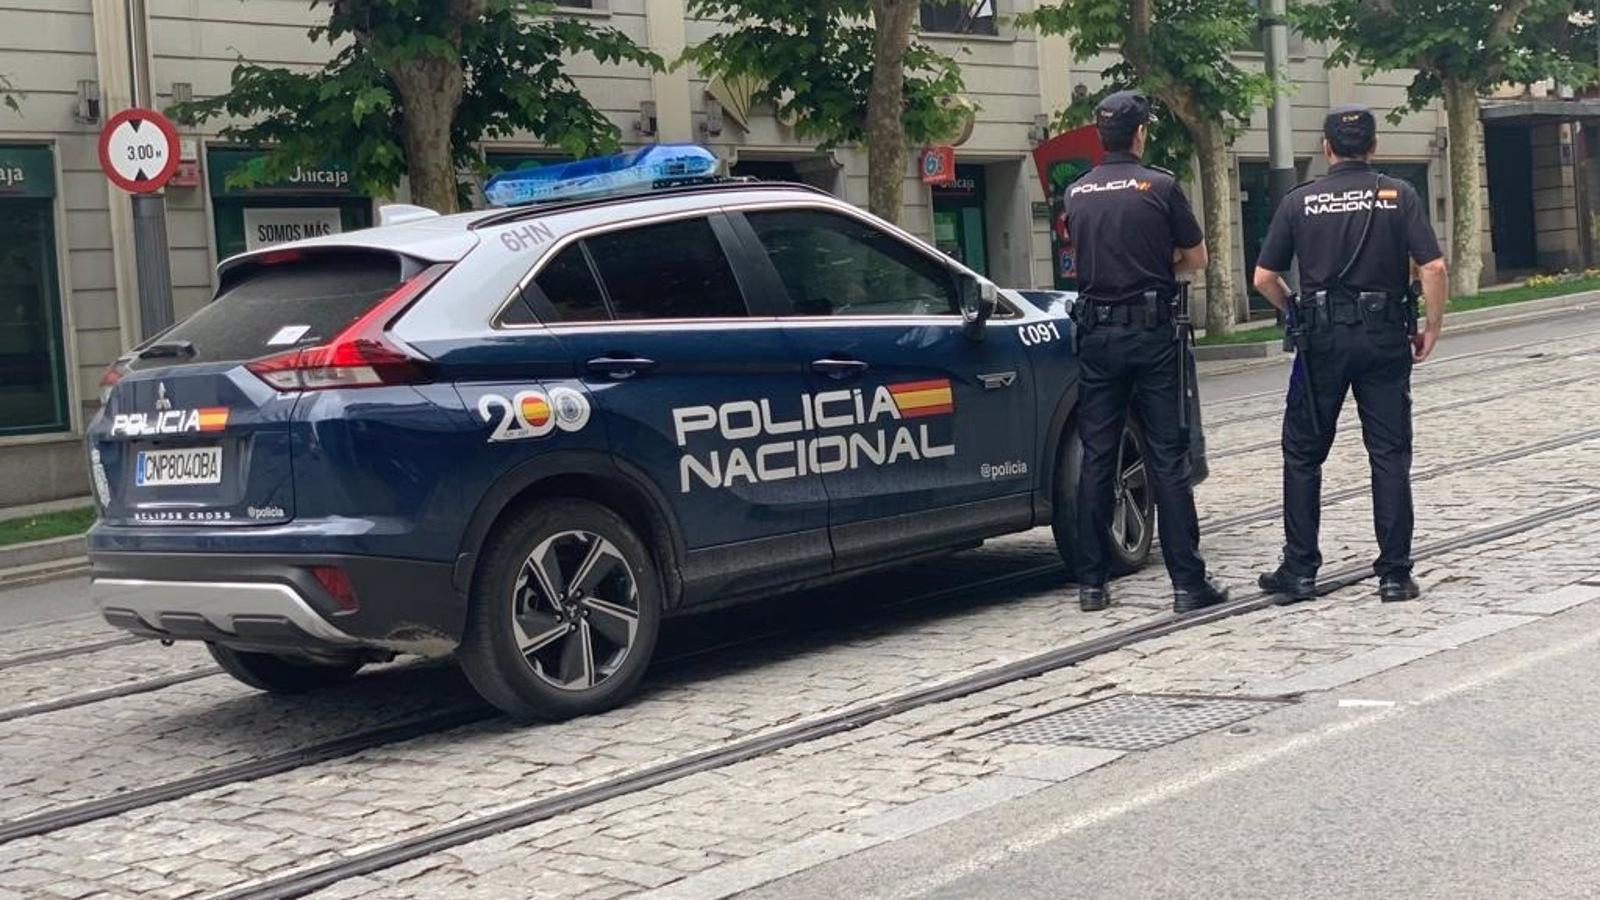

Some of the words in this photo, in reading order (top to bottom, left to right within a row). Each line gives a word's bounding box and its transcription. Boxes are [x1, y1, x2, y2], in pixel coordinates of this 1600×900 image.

[1305, 199, 1398, 216] NACIONAL
[258, 224, 301, 243] SOMOS
[500, 221, 555, 252] 6HN
[1027, 321, 1061, 344] 091
[144, 452, 218, 481] CNP8040BA
[679, 423, 956, 494] NACIONAL
[980, 459, 1028, 480] @policia
[188, 511, 232, 520] CROSS
